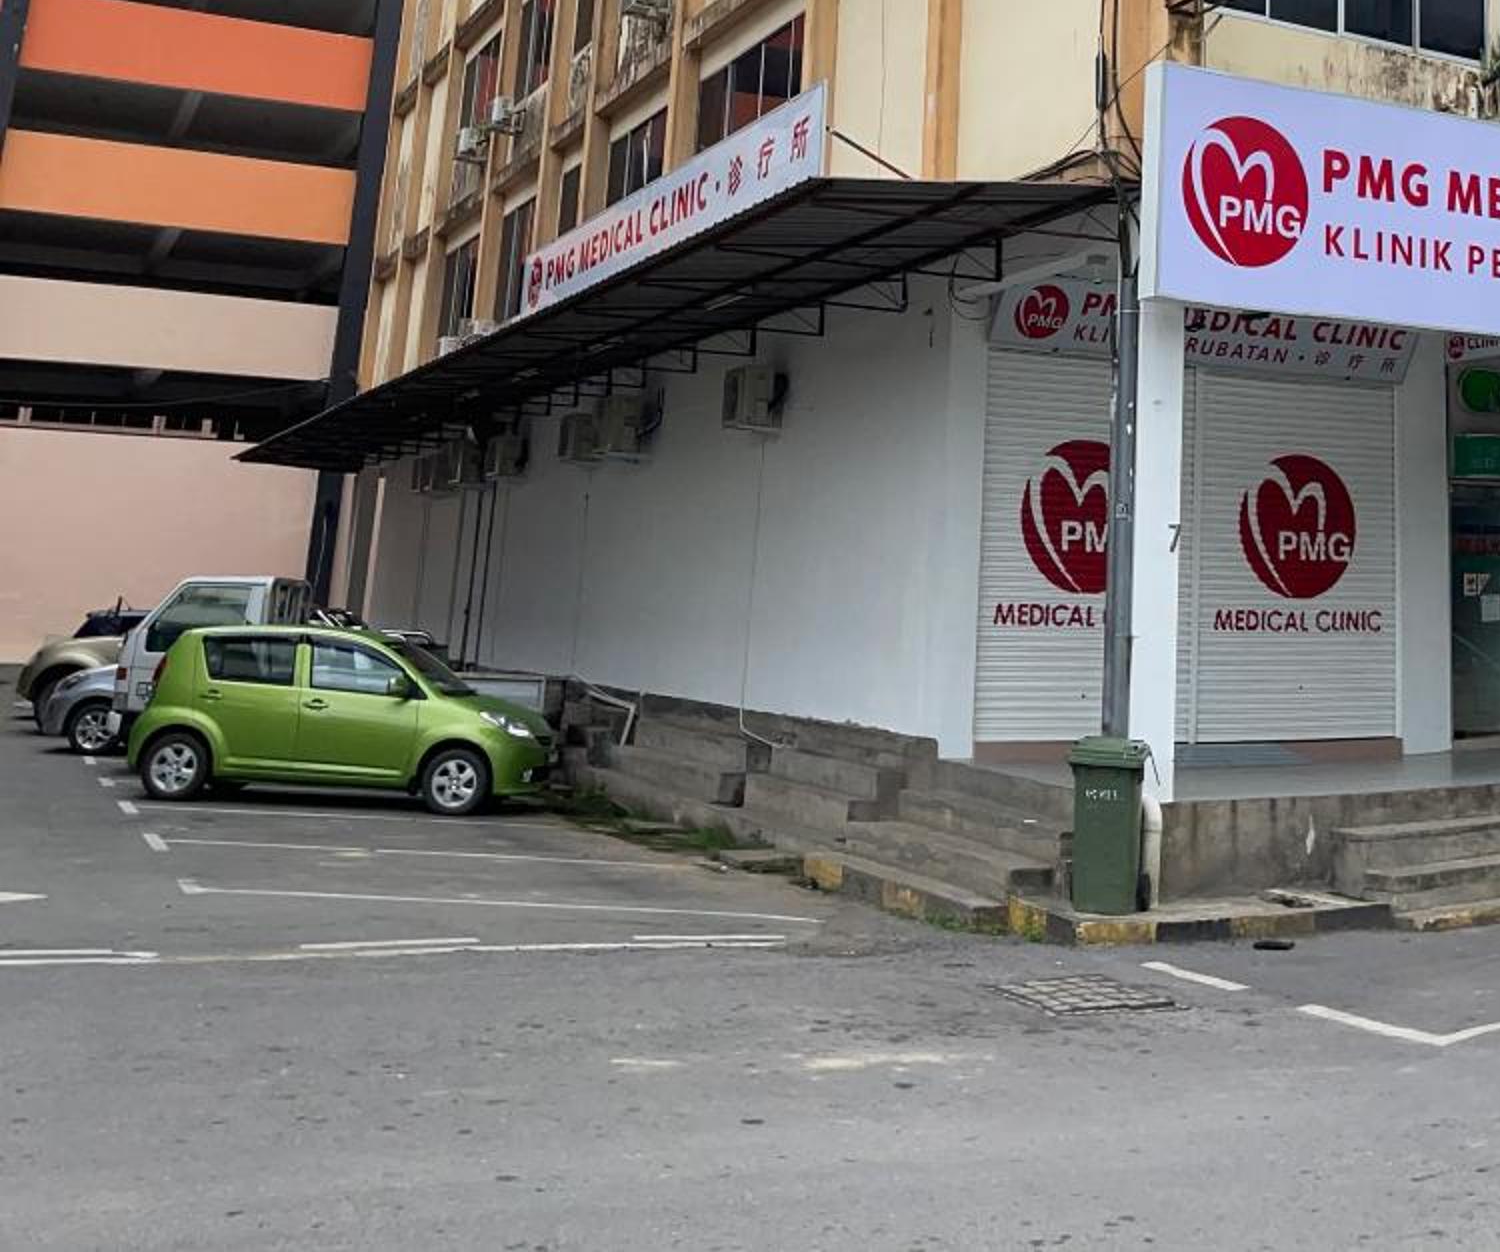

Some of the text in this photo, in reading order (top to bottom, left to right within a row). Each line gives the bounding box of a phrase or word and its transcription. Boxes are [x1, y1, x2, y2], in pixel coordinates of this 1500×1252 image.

[1323, 149, 1430, 207] PMG
[545, 116, 811, 290] PMG MEDICAL CLINIC 诊疗所
[1219, 195, 1301, 239] PMG
[1325, 225, 1453, 271] KLINIK
[1027, 314, 1063, 329] PMG
[1081, 291, 1118, 317] PM
[1313, 321, 1408, 351] CLINIC
[1185, 337, 1289, 365] RUBATAN
[1061, 521, 1107, 553] PM
[1168, 523, 1181, 553] 7
[1278, 531, 1353, 562] PMG
[993, 604, 1095, 627] MEDICAL
[1214, 609, 1382, 632] MEDICAL CLINIC
